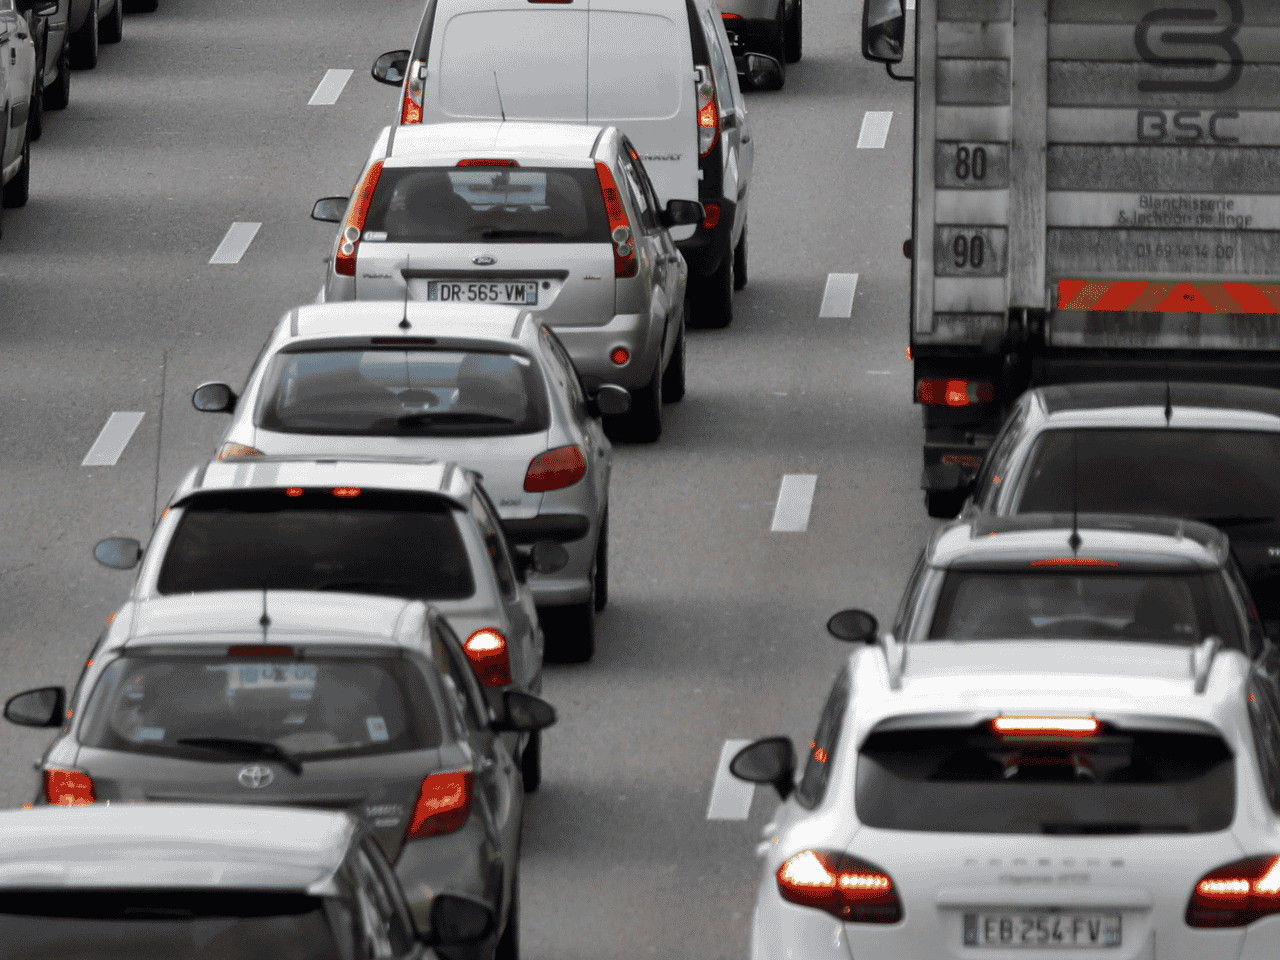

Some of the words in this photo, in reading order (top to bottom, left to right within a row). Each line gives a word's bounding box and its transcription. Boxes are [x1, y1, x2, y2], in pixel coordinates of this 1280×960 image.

[1137, 111, 1239, 144] BSC
[956, 146, 987, 181] 80
[1118, 210, 1128, 224] &
[1134, 211, 1191, 225] location
[1195, 212, 1213, 224] de
[1219, 212, 1253, 228] linge
[1139, 195, 1235, 210] Blanchisserie
[953, 235, 984, 268] 90
